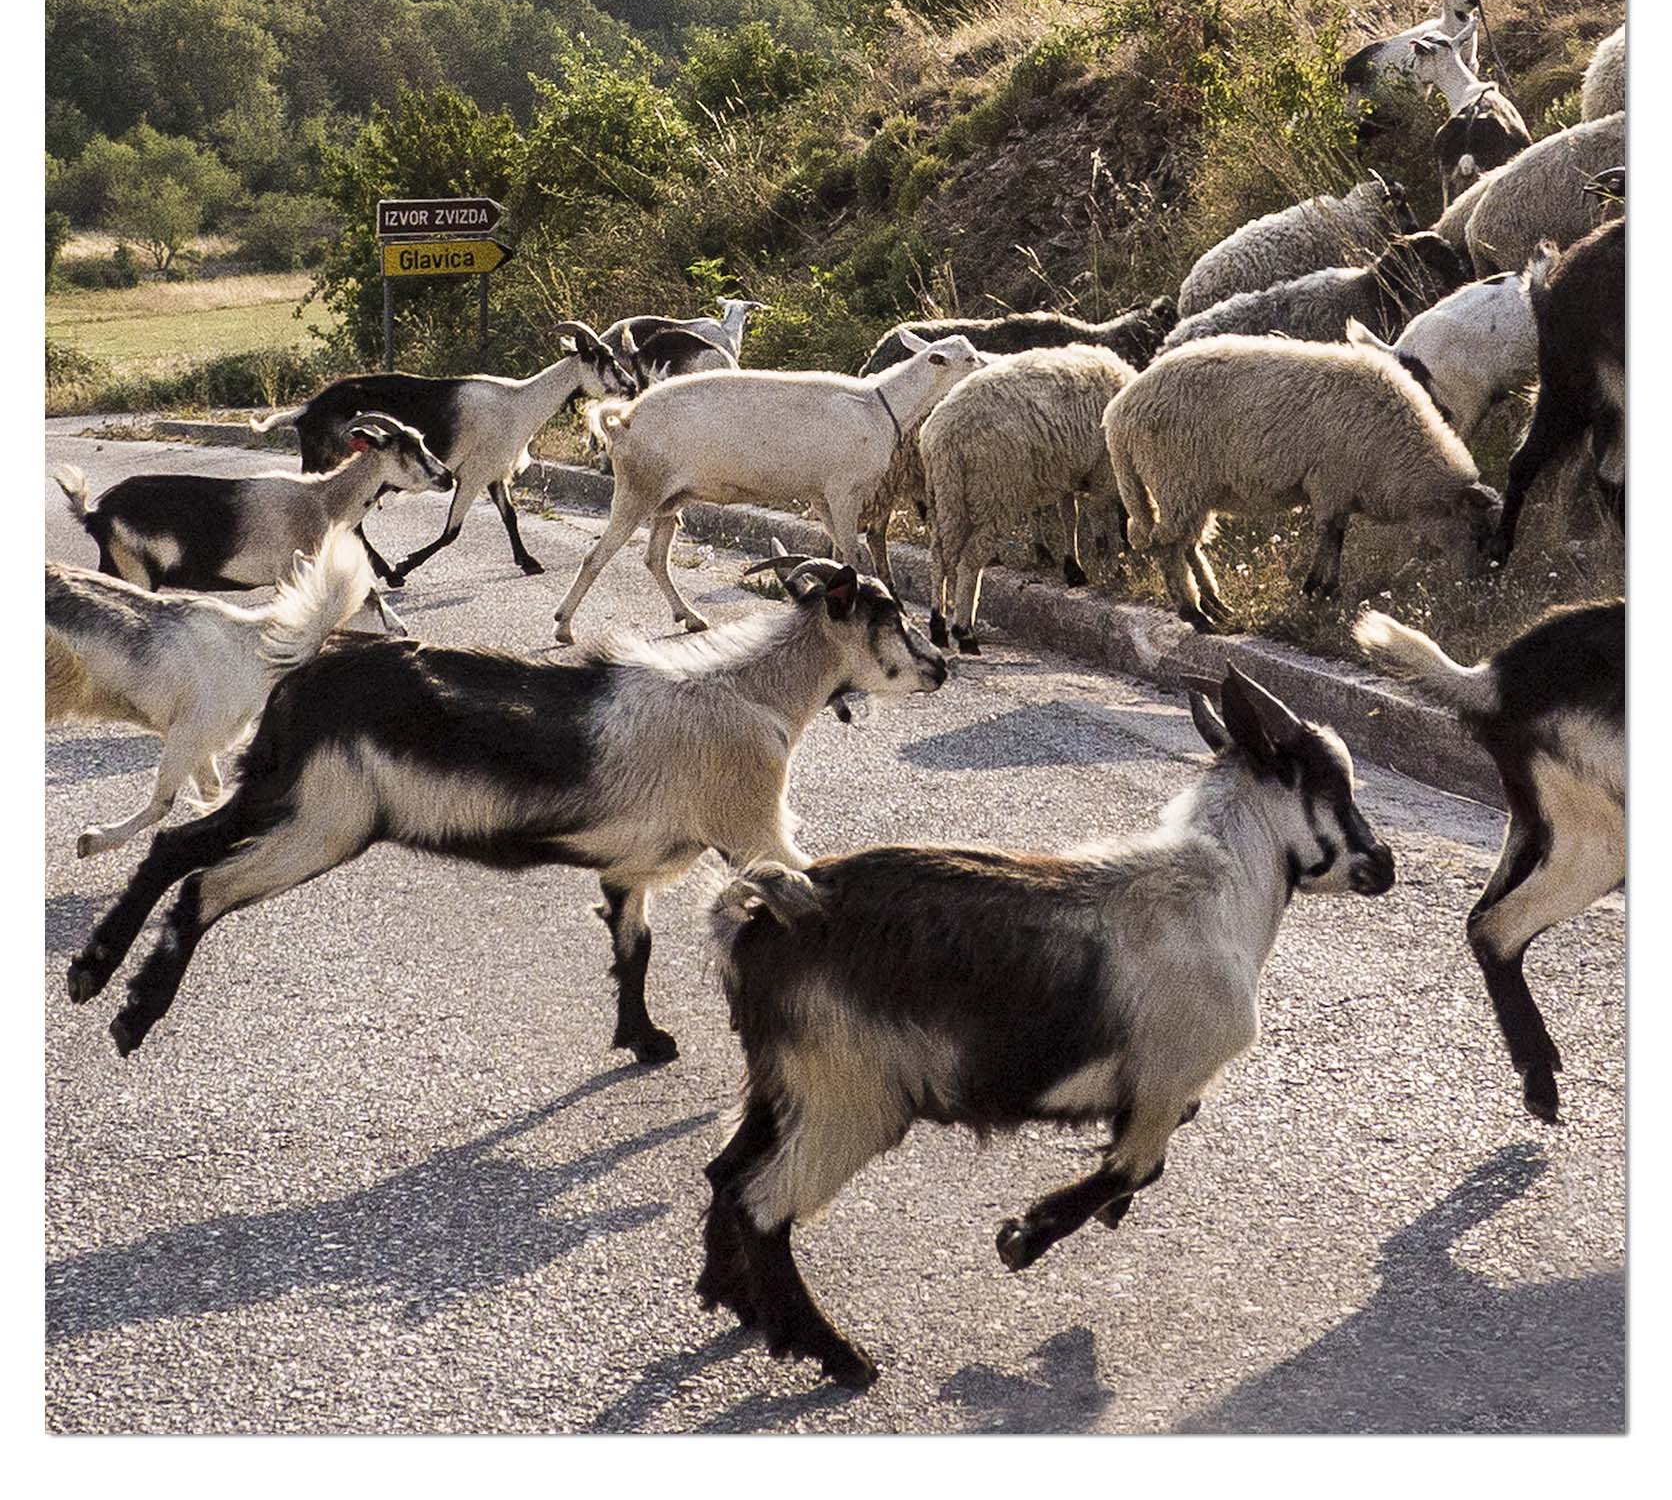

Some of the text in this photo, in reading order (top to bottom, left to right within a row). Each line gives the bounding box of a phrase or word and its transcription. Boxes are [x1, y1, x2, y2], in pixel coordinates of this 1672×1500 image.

[384, 208, 489, 226] IZVOR ZVIZDA
[399, 248, 475, 270] Glavica
